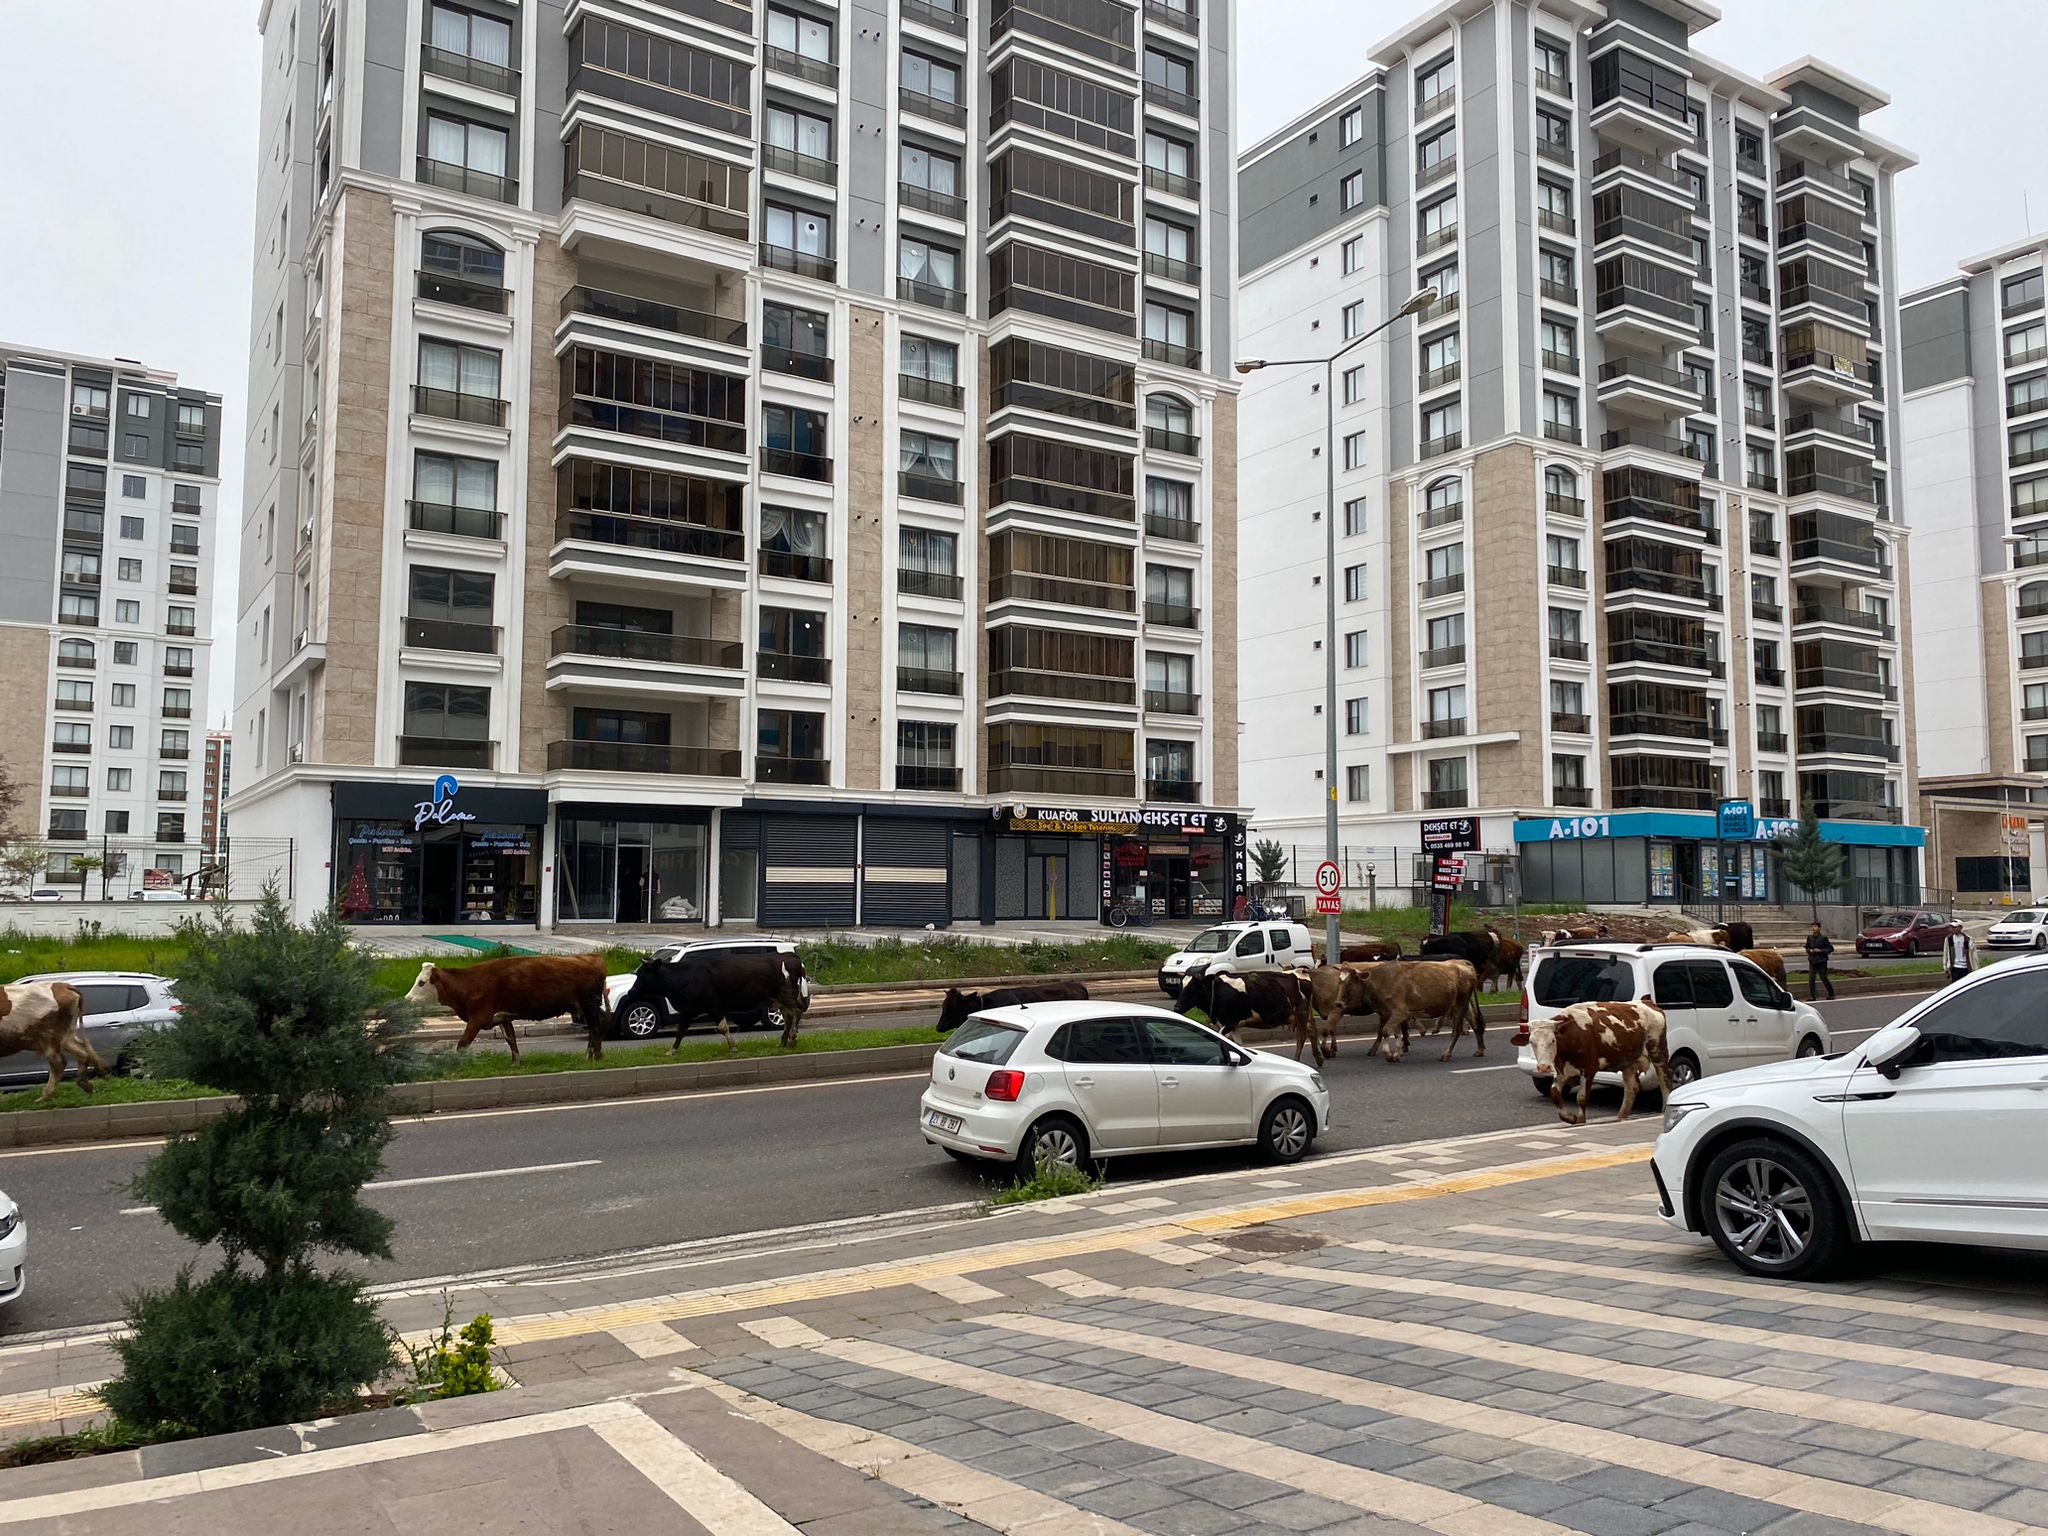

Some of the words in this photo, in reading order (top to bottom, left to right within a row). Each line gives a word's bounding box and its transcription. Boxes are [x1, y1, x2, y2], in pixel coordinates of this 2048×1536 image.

[414, 799, 476, 831] Paloma
[1038, 808, 1079, 821] KUAFÖR
[1191, 813, 1207, 826] ET
[1450, 821, 1458, 830] ET
[1321, 870, 1337, 887] 50
[1318, 900, 1340, 911] YAVAŞ
